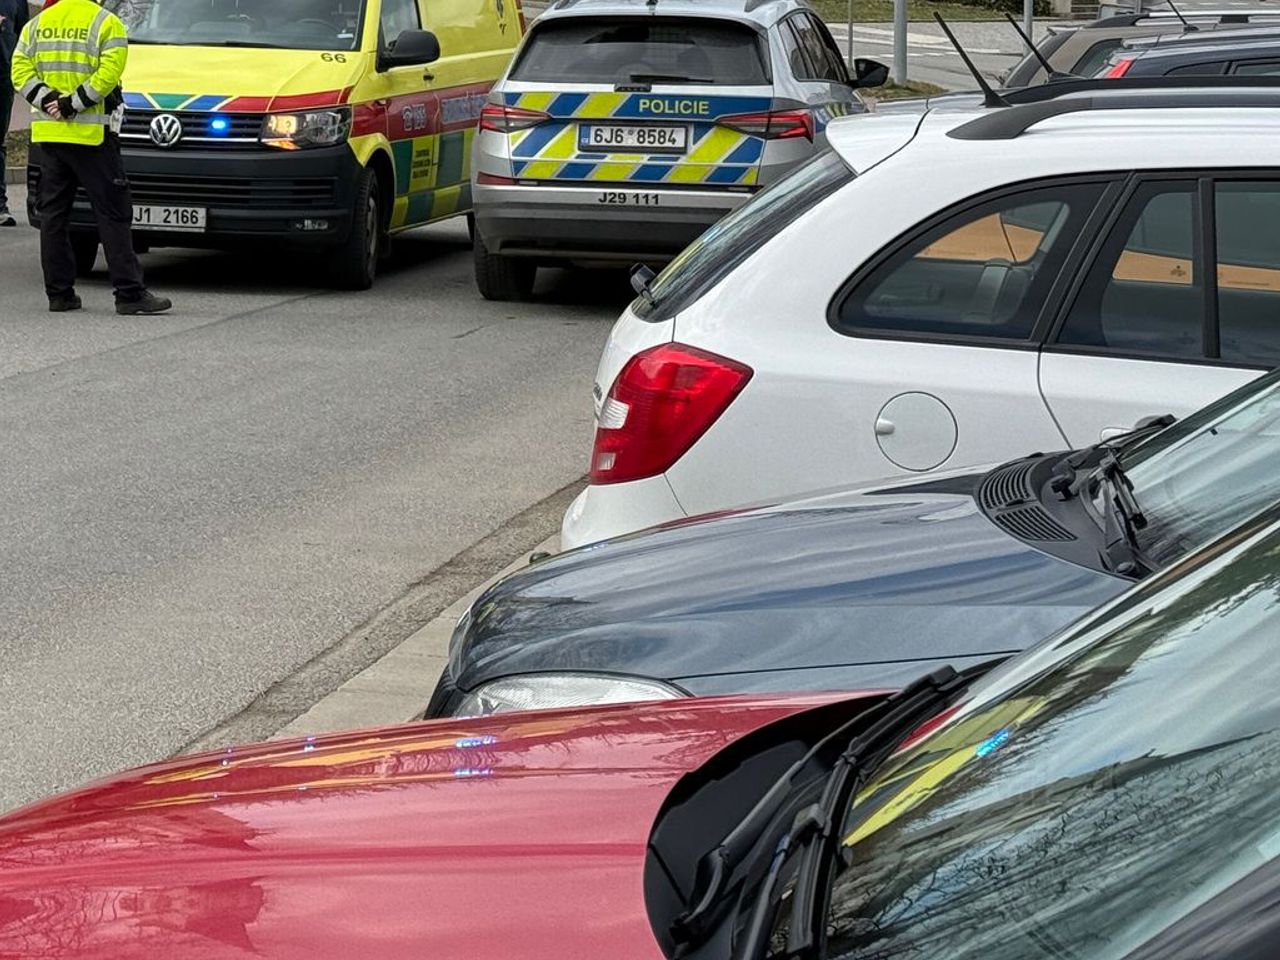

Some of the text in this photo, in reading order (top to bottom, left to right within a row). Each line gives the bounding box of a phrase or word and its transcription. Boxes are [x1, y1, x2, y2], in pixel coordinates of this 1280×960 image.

[320, 52, 347, 64] 66
[639, 98, 710, 115] POLICIE
[593, 128, 624, 144] 6J6
[636, 128, 677, 145] 8584
[598, 192, 660, 205] J29 111
[134, 207, 199, 224] J1 2166
